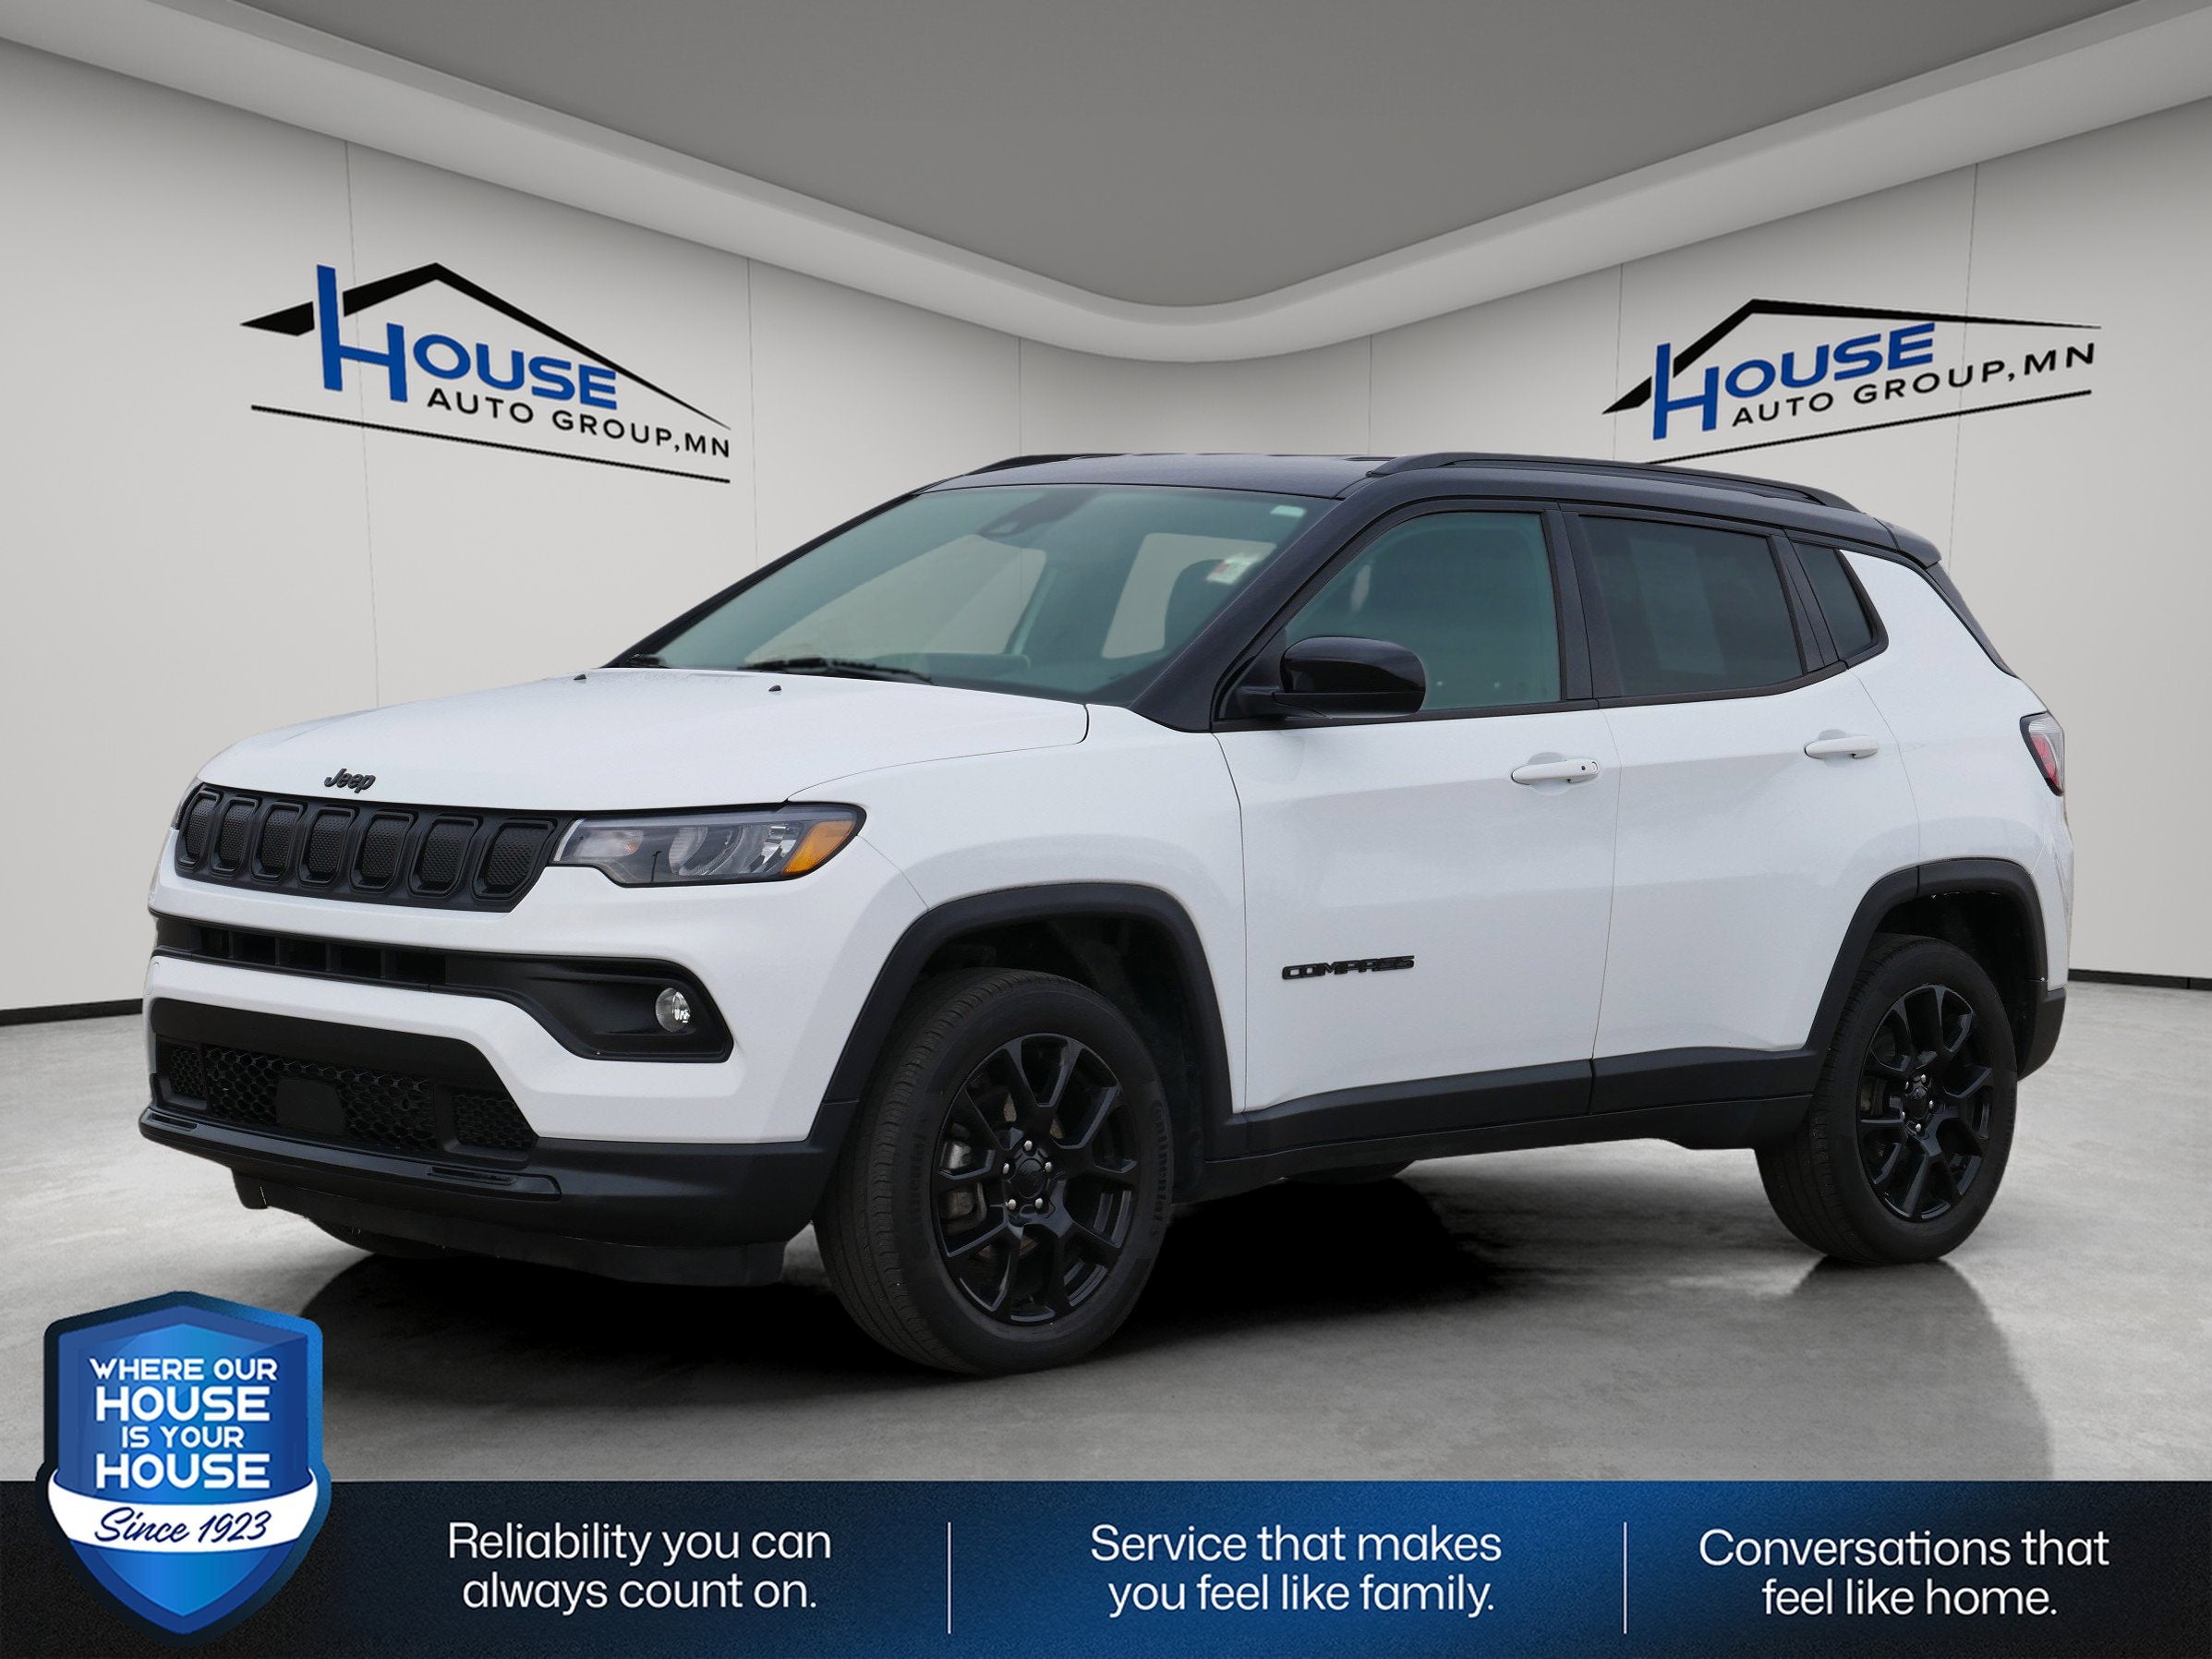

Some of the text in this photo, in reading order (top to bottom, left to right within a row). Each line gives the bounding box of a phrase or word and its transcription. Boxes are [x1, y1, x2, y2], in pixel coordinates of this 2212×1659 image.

[317, 264, 617, 409] HOUSE
[1653, 323, 1934, 439] HOUSE
[428, 388, 533, 423] AUTO
[1733, 393, 1832, 426] AUTO
[324, 769, 376, 793] Jeep
[1282, 956, 1414, 980] COMPASS
